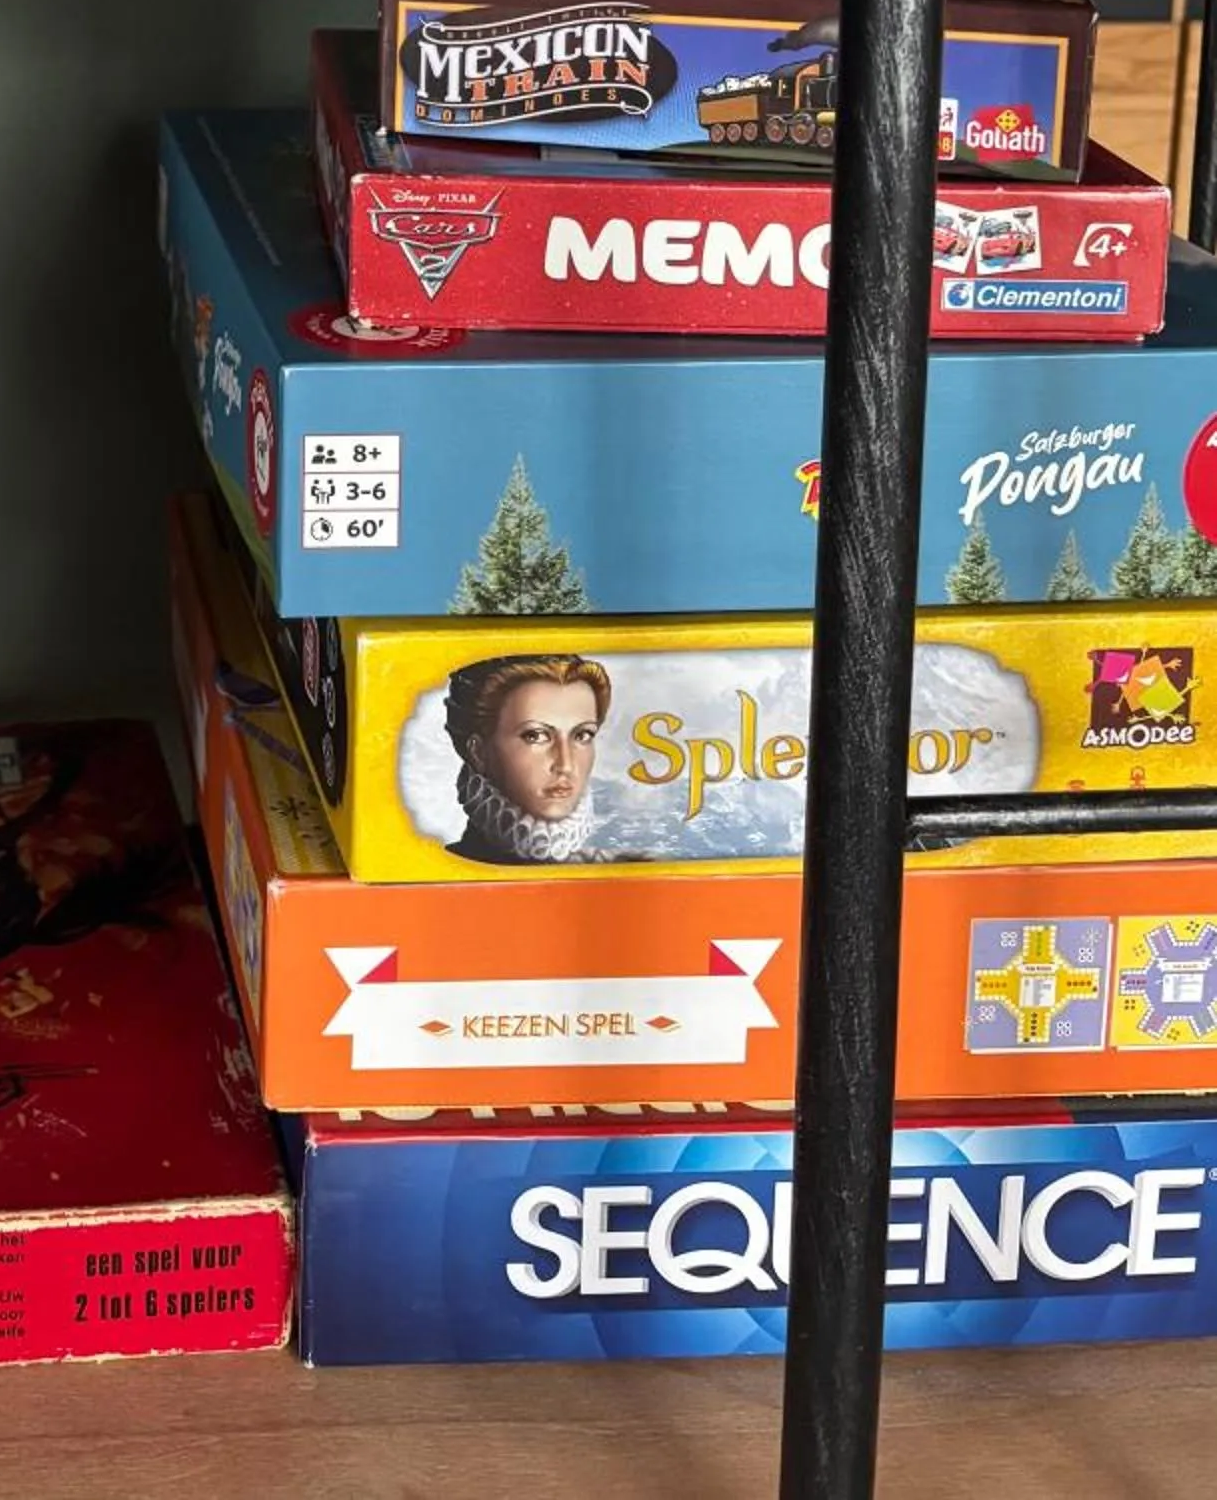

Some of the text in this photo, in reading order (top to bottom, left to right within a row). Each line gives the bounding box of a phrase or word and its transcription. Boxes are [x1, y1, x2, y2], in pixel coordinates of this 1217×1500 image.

[465, 59, 649, 102] TRAIN
[966, 121, 1046, 153] Goliath
[438, 193, 476, 204] PIXAR
[385, 215, 475, 234] Cars
[1089, 234, 1127, 259] 4+
[977, 285, 1121, 309] Clementoni
[352, 443, 382, 464] 8+
[1015, 421, 1136, 463] Salzburger
[346, 481, 387, 502] 3-6
[958, 450, 1145, 526] Pongau
[627, 688, 994, 822] Spleor
[462, 1013, 637, 1038] KEEZEN SPEL
[506, 1166, 1207, 1300] SEQENCE
[86, 1244, 242, 1277] een spel voor
[75, 1285, 255, 1322] 2 tot 6 spelers
